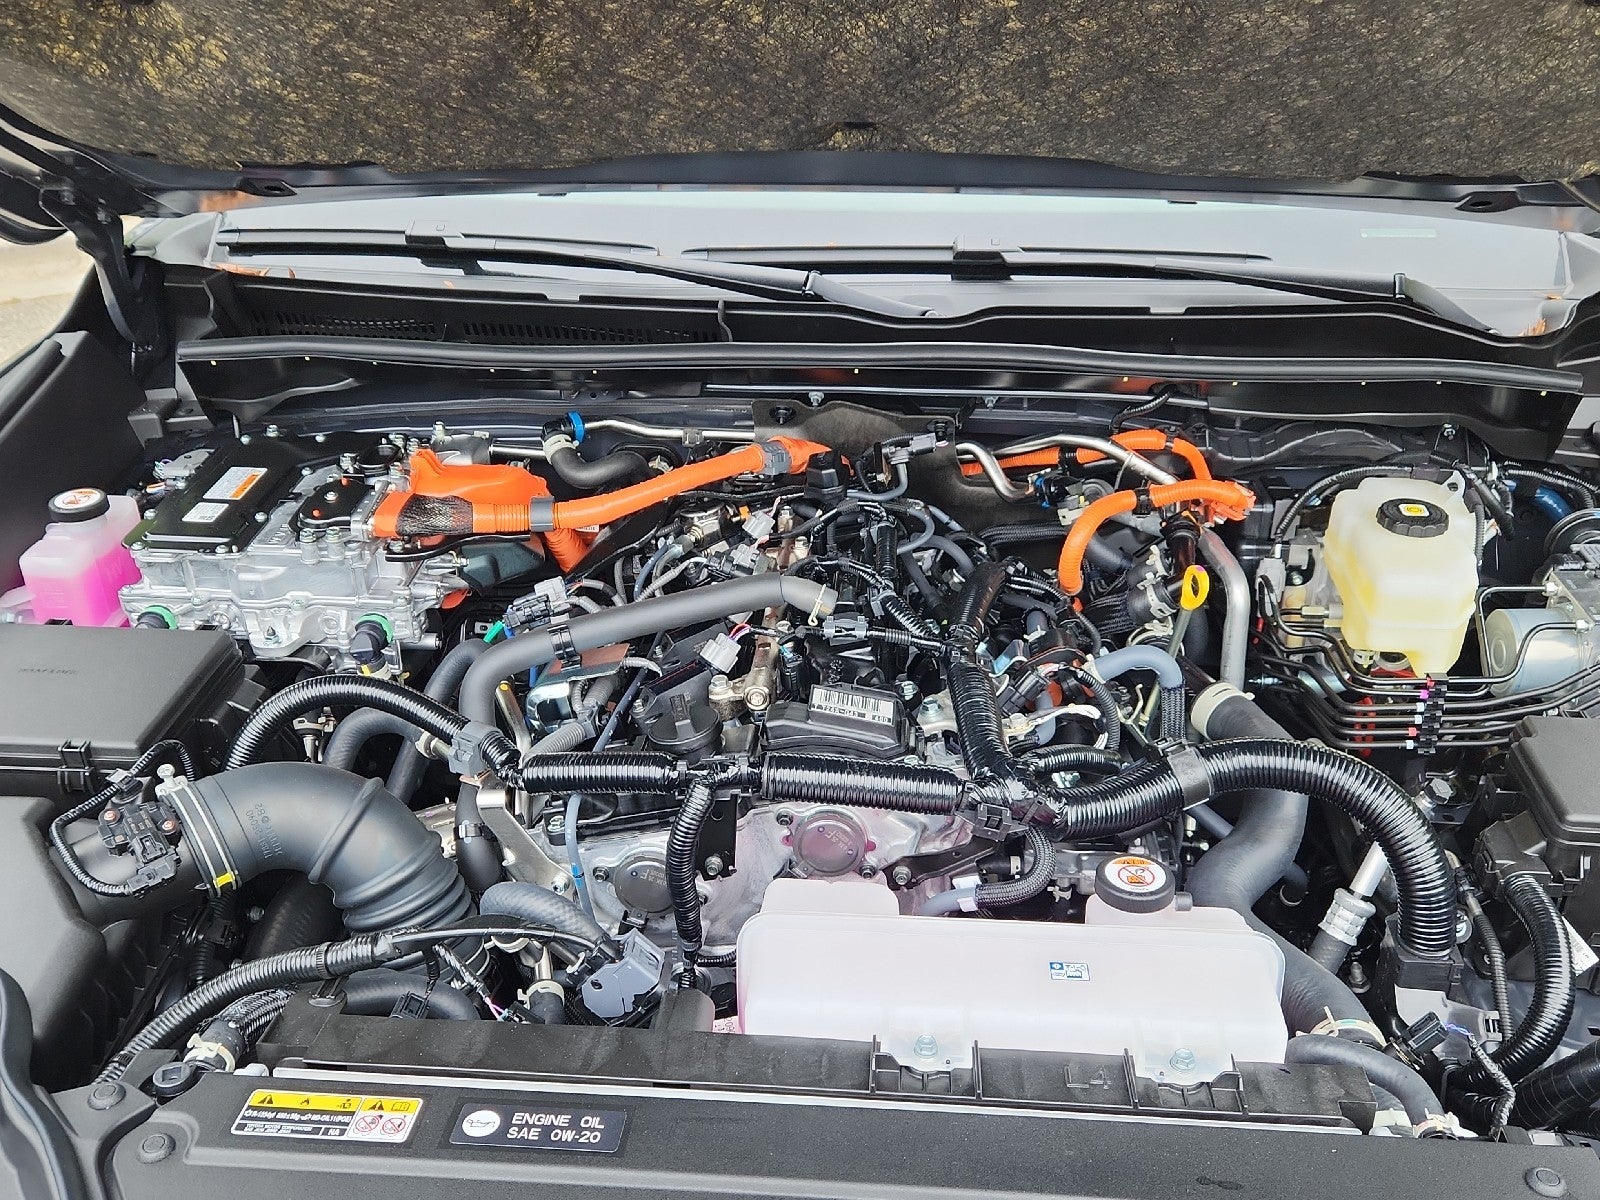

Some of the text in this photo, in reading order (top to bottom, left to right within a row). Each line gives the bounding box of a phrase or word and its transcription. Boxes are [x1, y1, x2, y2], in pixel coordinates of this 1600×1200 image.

[511, 1112, 605, 1129] ENGINE OIL
[506, 1127, 602, 1144] SAE 0W-20
